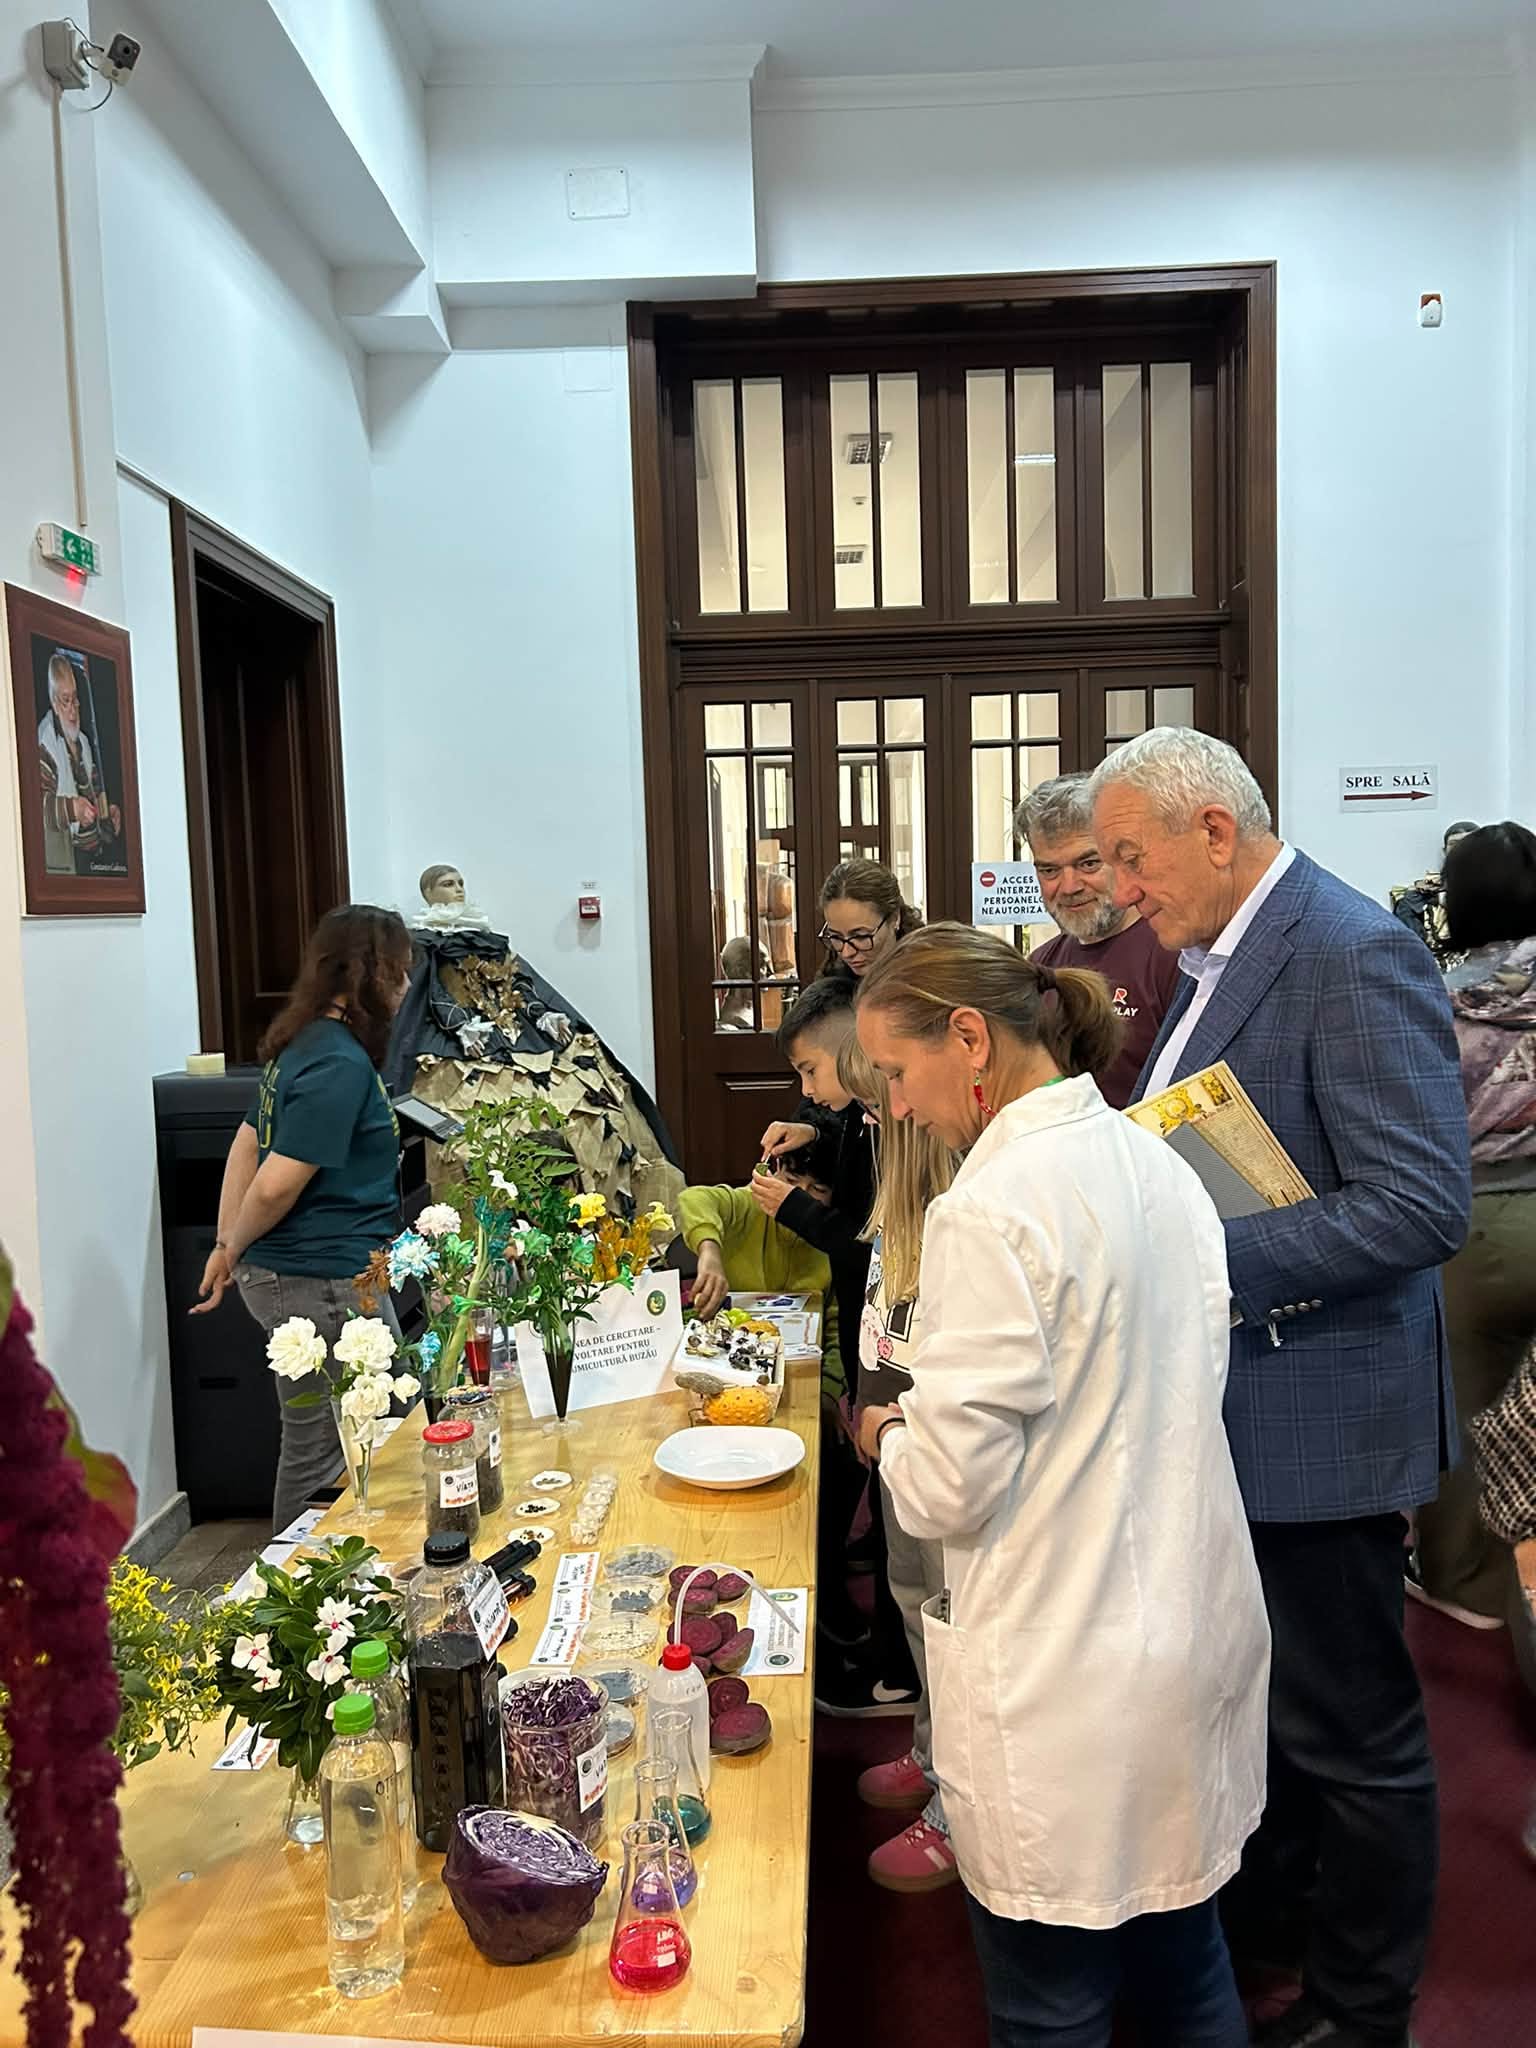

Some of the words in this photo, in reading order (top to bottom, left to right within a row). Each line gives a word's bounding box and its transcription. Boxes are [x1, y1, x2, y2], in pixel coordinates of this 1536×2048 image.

[1346, 776, 1383, 788] SPRE
[1393, 772, 1431, 786] SALĂ
[1002, 876, 1034, 884] ACCES
[997, 886, 1039, 894] INTERZIS
[984, 896, 1044, 905] PERSOANELO
[1113, 1006, 1139, 1017] PLAY
[575, 1338, 592, 1348] NEA
[593, 1335, 605, 1345] DE
[606, 1326, 655, 1342] CERCETARE
[574, 1345, 615, 1361] VOLTARE
[616, 1338, 650, 1353] PENTRU
[571, 1356, 628, 1374] UMICULTURĂ
[629, 1349, 658, 1362] BUZĂU
